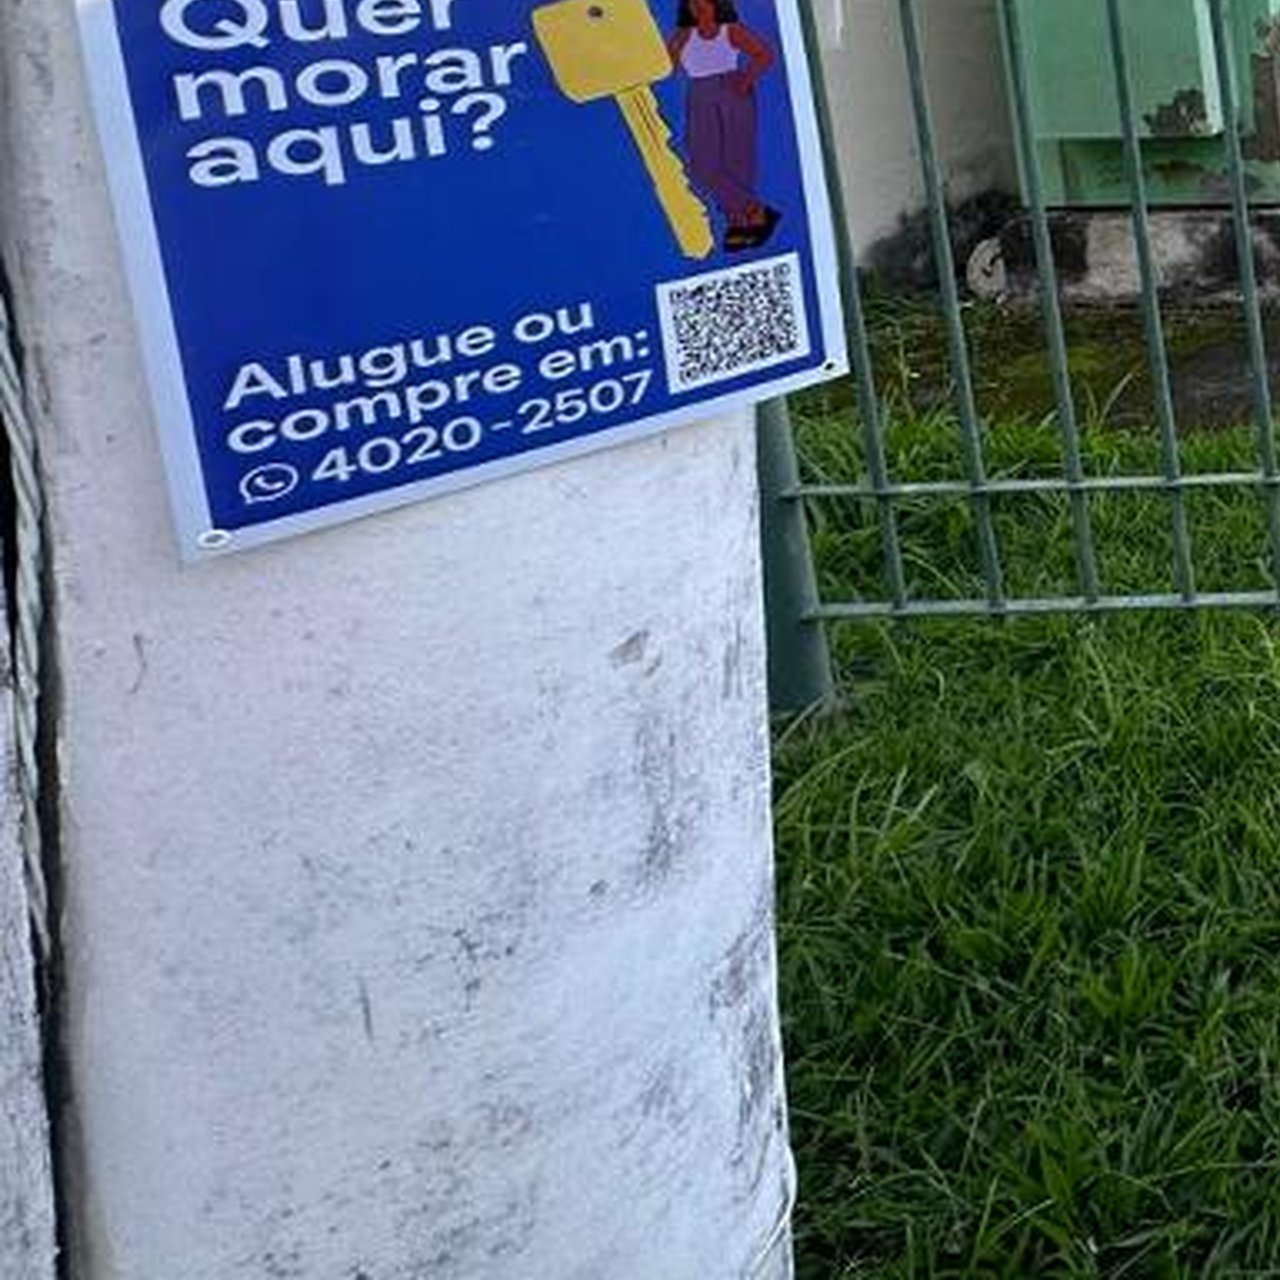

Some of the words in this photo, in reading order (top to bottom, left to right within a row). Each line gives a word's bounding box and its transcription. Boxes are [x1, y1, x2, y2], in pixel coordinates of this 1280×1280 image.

[171, 39, 529, 121] morar
[185, 92, 508, 187] aqui?
[223, 324, 497, 412] Alugue
[512, 300, 595, 344] ou
[226, 361, 523, 455] compre
[537, 329, 652, 381] em:
